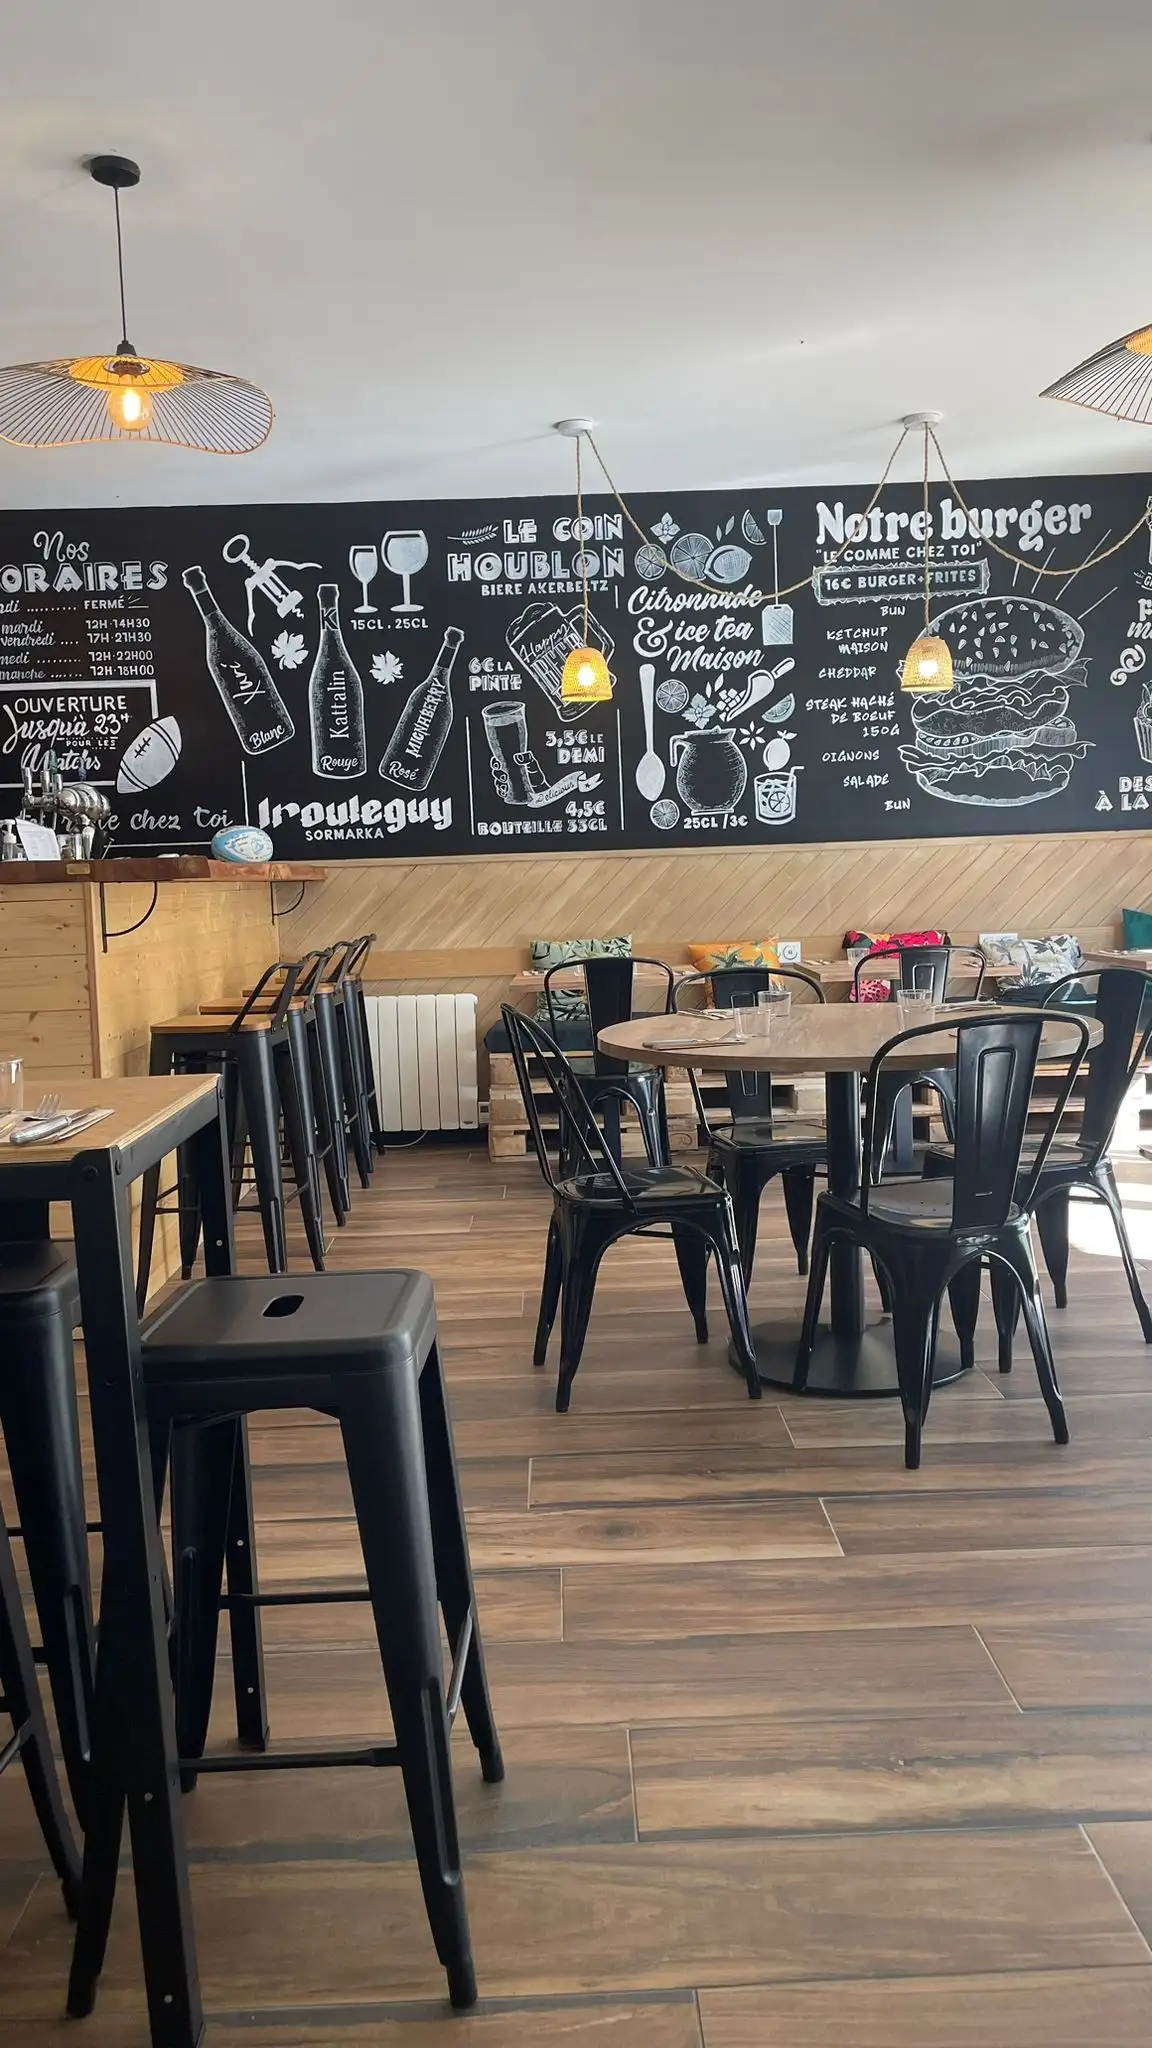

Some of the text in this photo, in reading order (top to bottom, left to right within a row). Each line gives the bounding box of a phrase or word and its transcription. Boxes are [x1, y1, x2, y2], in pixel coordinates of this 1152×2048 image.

[503, 513, 624, 543] LE COIN
[815, 498, 1092, 551] Notre burger
[33, 531, 90, 562] Nos
[843, 547, 900, 562] COMME
[906, 545, 944, 559] CHEZ
[447, 545, 625, 581] HOUBLON
[482, 583, 523, 597] BIERE
[825, 577, 852, 591] 16€
[84, 594, 125, 610] FERMÉ
[627, 584, 763, 614] Citronnade
[880, 606, 905, 617] BUN
[1, 619, 44, 635] mardi
[350, 617, 429, 630] 15CL 25CL
[0, 631, 56, 647] vendredi
[633, 614, 754, 658] & ice tea
[826, 626, 888, 640] KETCHUP
[519, 623, 571, 664] Happy
[838, 641, 888, 654] MAISON
[468, 657, 514, 673] 6€ LA
[666, 645, 764, 673] Maison
[818, 666, 877, 681] CHEDDAR
[469, 674, 523, 692] PINTE
[14, 695, 127, 714] OUVERTURE
[327, 670, 350, 739] Kattalin
[805, 692, 895, 711] STEAK HACHÉ
[831, 710, 896, 724] DE BOEUF
[249, 724, 285, 749] Blanc
[545, 729, 604, 748] 3,5€ LE
[862, 724, 900, 738] 150G
[66, 739, 116, 748] POUR LES
[320, 755, 359, 772] Rouge
[557, 746, 605, 764] DEMI
[822, 750, 880, 762] OIGNONS
[388, 760, 419, 780] Rosé
[843, 773, 889, 788] SALADE
[565, 800, 606, 818] 4,5€
[884, 798, 911, 811] BUN
[1121, 793, 1150, 811] LA
[130, 808, 181, 831] chez
[193, 805, 234, 828] toi
[258, 794, 453, 834] Irouleguy
[683, 816, 719, 829] 25CL
[305, 827, 385, 842] SORMARKA
[477, 818, 608, 836] BOUTEILLE 33CL
